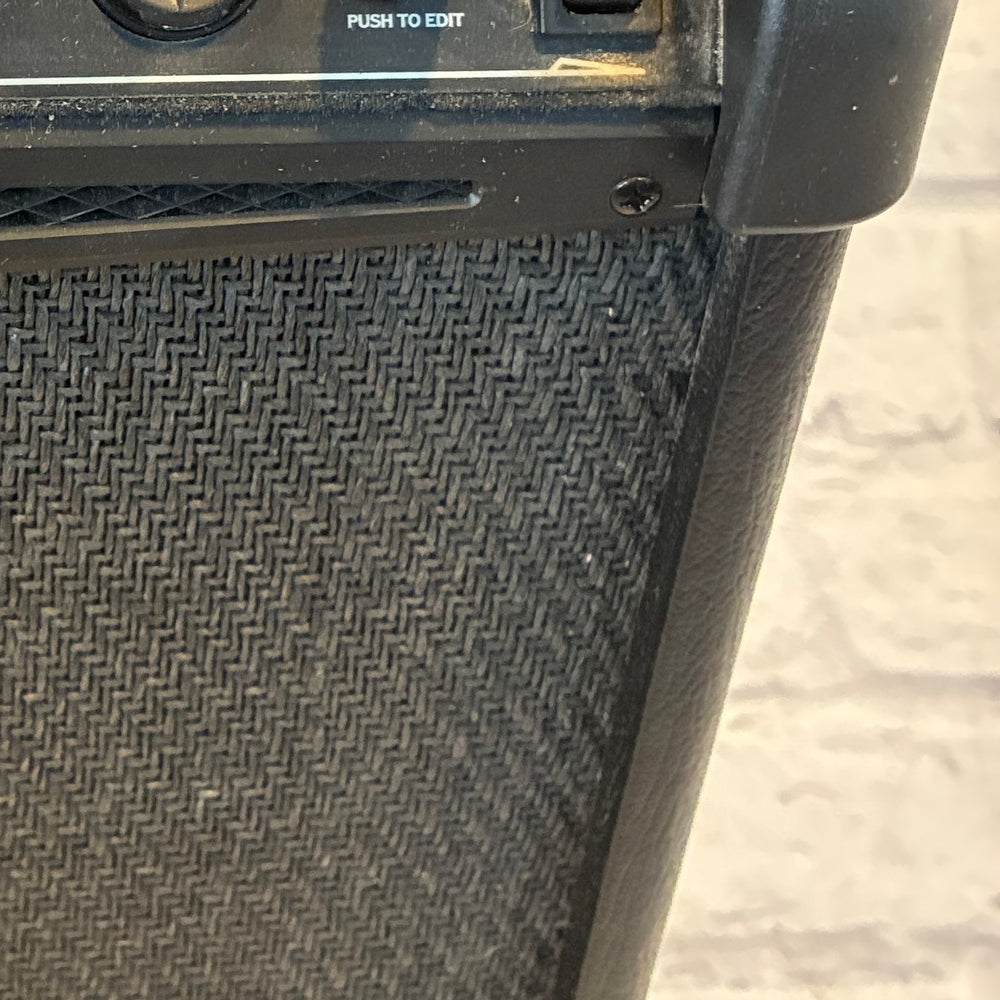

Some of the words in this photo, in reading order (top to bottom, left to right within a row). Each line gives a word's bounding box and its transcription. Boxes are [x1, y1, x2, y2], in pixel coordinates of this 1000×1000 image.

[347, 13, 394, 29] PUSH
[396, 13, 422, 28] TO
[425, 12, 465, 28] EDIT
